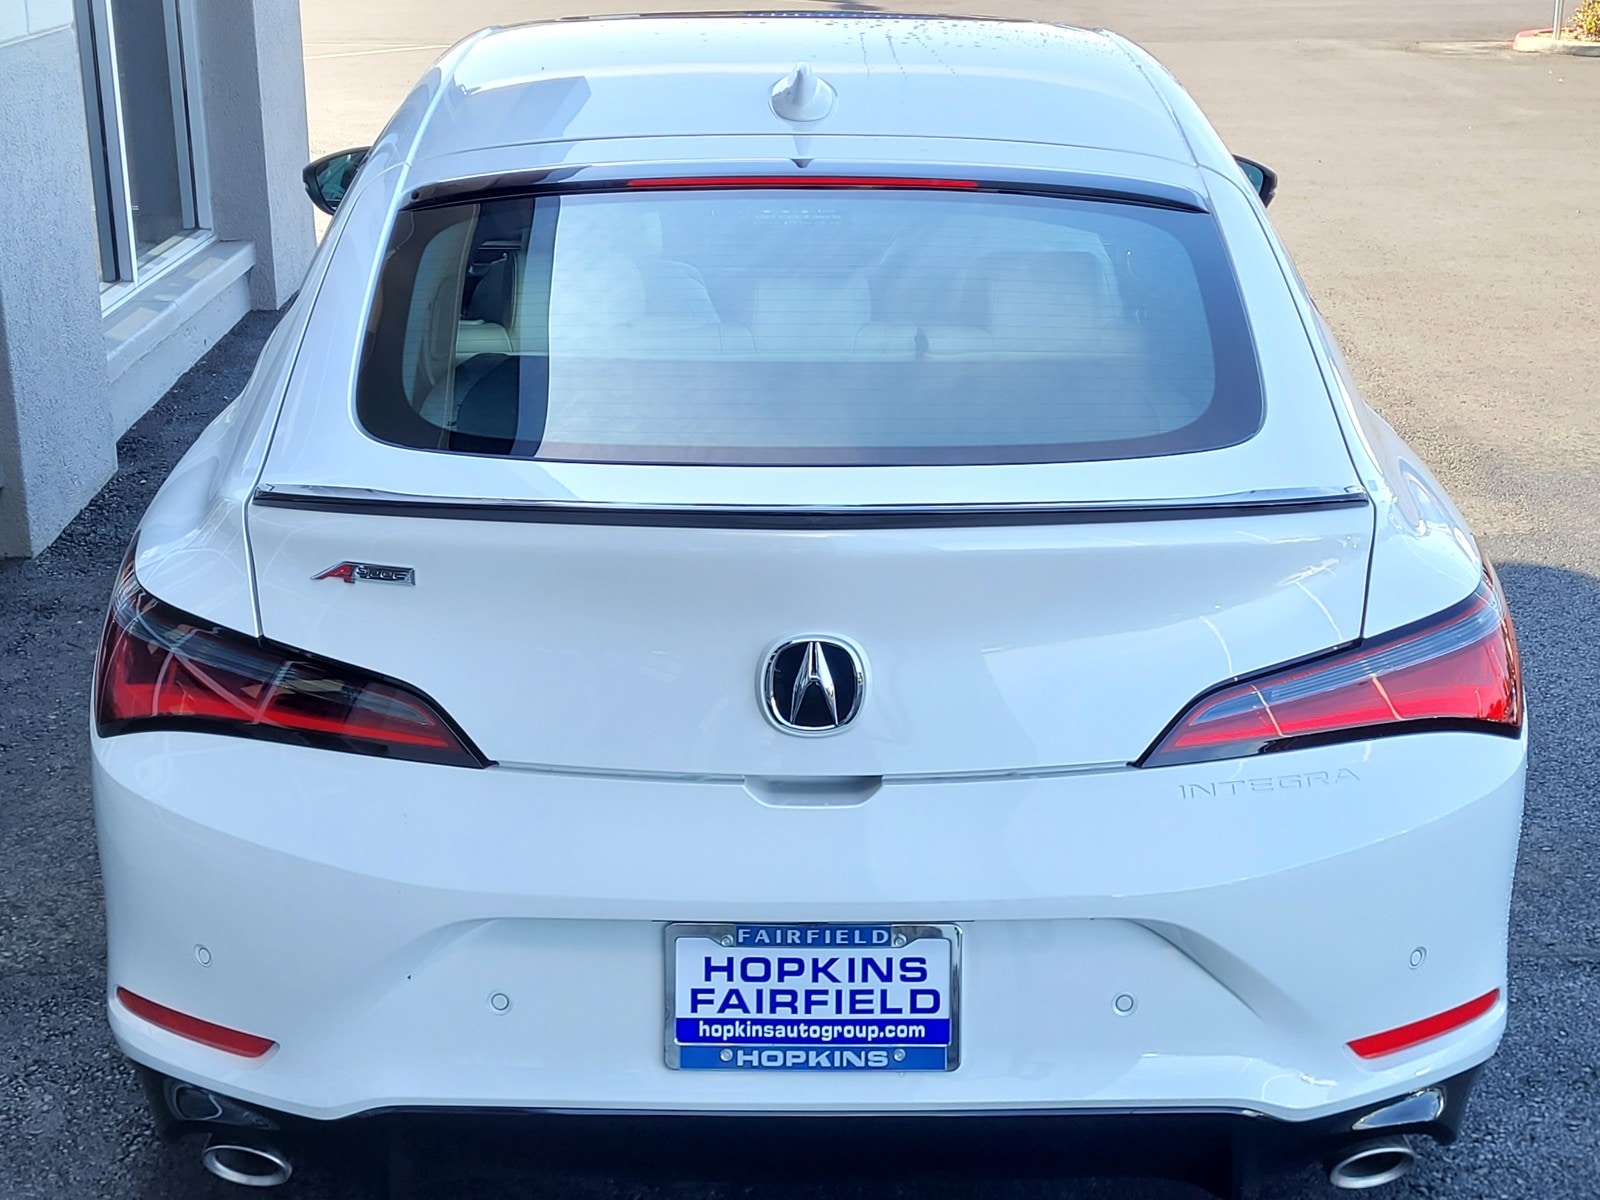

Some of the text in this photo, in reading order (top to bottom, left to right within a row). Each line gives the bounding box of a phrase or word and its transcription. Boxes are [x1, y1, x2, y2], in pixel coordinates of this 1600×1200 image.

[1178, 767, 1361, 800] INTEGRA
[738, 928, 889, 945] FAIRFIELD
[703, 956, 928, 984] HOPKINS
[690, 988, 941, 1015] FAIRFIELD
[699, 1021, 926, 1041] hopkinsautogroup.com
[736, 1050, 889, 1067] HOPKINS
